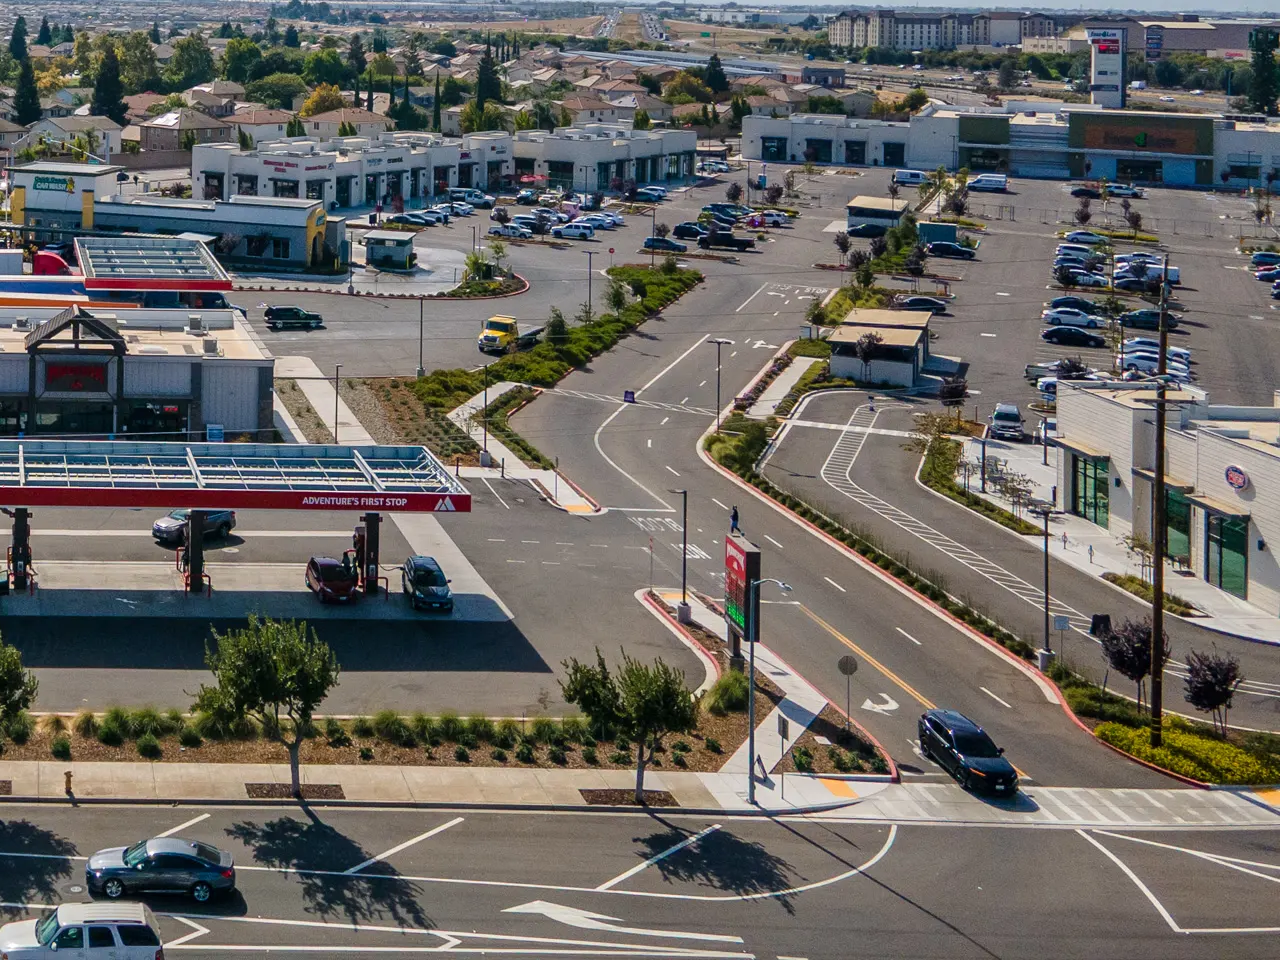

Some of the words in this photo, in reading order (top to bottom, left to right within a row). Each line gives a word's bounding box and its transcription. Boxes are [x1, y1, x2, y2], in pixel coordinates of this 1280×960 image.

[302, 496, 359, 506] ADVENTURE'S
[360, 497, 383, 506] FIRST
[385, 497, 408, 507] STOP
